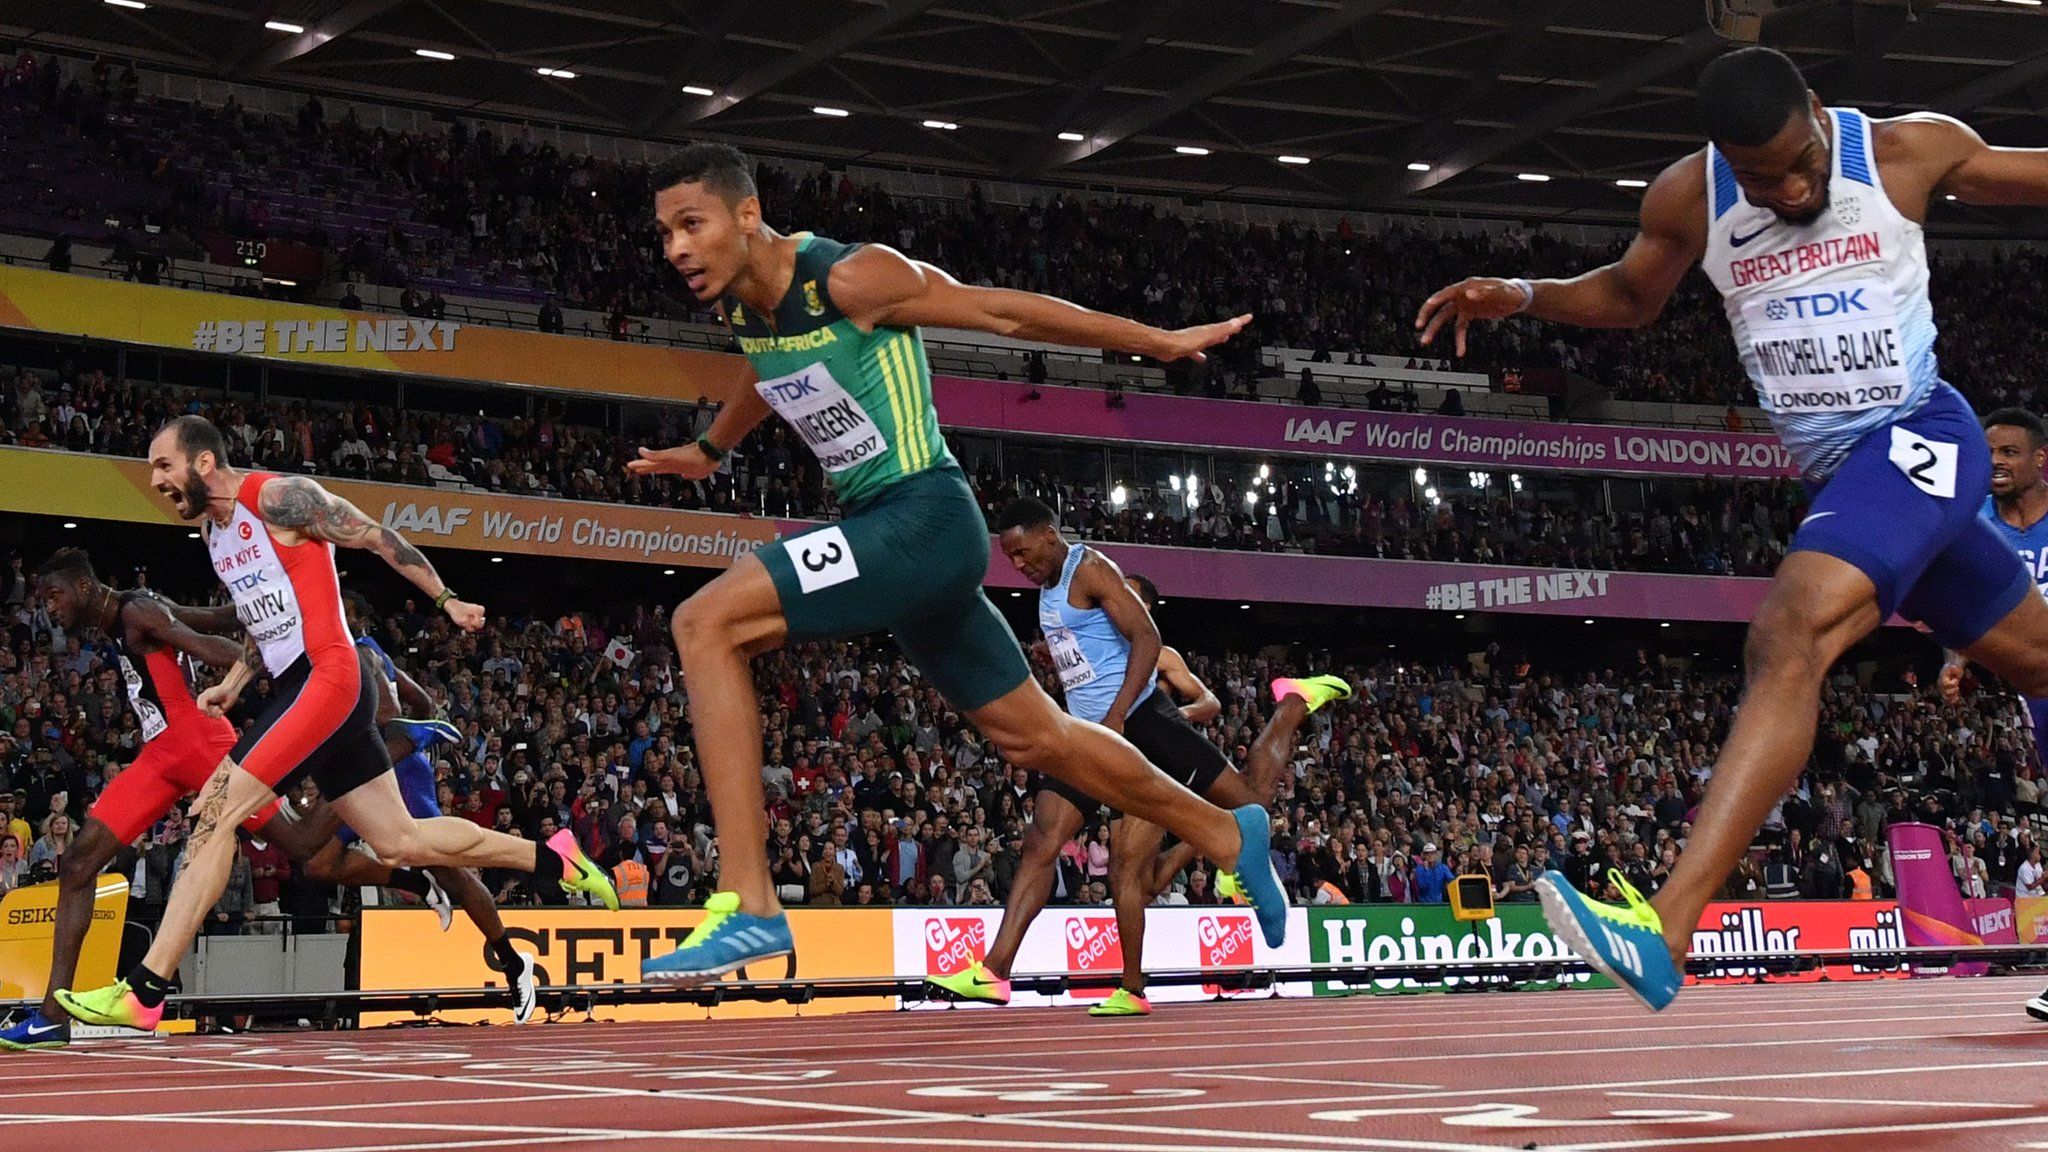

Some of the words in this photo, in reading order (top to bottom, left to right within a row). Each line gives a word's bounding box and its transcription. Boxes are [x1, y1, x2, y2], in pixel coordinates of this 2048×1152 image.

[236, 240, 267, 258] 210
[1730, 248, 1795, 287] GREAT
[1796, 231, 1881, 273] BRITAIN
[1784, 288, 1869, 319] TDK
[191, 320, 267, 353] #BE
[273, 320, 348, 353] THE
[355, 320, 461, 353] NEXT
[1755, 328, 1899, 377] MITCHELL-BLAKE
[771, 375, 820, 403] TDK
[1771, 391, 1851, 409] LONDON
[1855, 384, 1904, 404] 2017
[819, 454, 849, 468] DON
[845, 436, 877, 461] 2017
[1284, 417, 1357, 445] IAAF
[1366, 423, 1433, 451] World
[1440, 427, 1607, 465] Championships
[1613, 435, 1732, 468] LONDON
[1734, 443, 1793, 469] 2017
[1909, 442, 1937, 486] 2
[381, 501, 473, 535] IAAF
[482, 510, 563, 543] World
[572, 517, 764, 562] Championships
[802, 541, 842, 573] 3
[231, 568, 268, 593] TDK
[1425, 582, 1477, 611] #BE
[1479, 576, 1532, 608] THE
[1536, 572, 1610, 602] NEXT
[8, 907, 57, 925] SEIK
[92, 909, 117, 921] EIKO
[1066, 915, 1099, 951] GL
[1199, 915, 1231, 948] GL
[926, 915, 961, 952] GL
[937, 921, 985, 972] events
[1209, 919, 1253, 966] events
[1692, 908, 1800, 978] müller
[1849, 908, 1908, 974] mül
[482, 927, 798, 1002] SEI
[1307, 1102, 1735, 1128] 2
